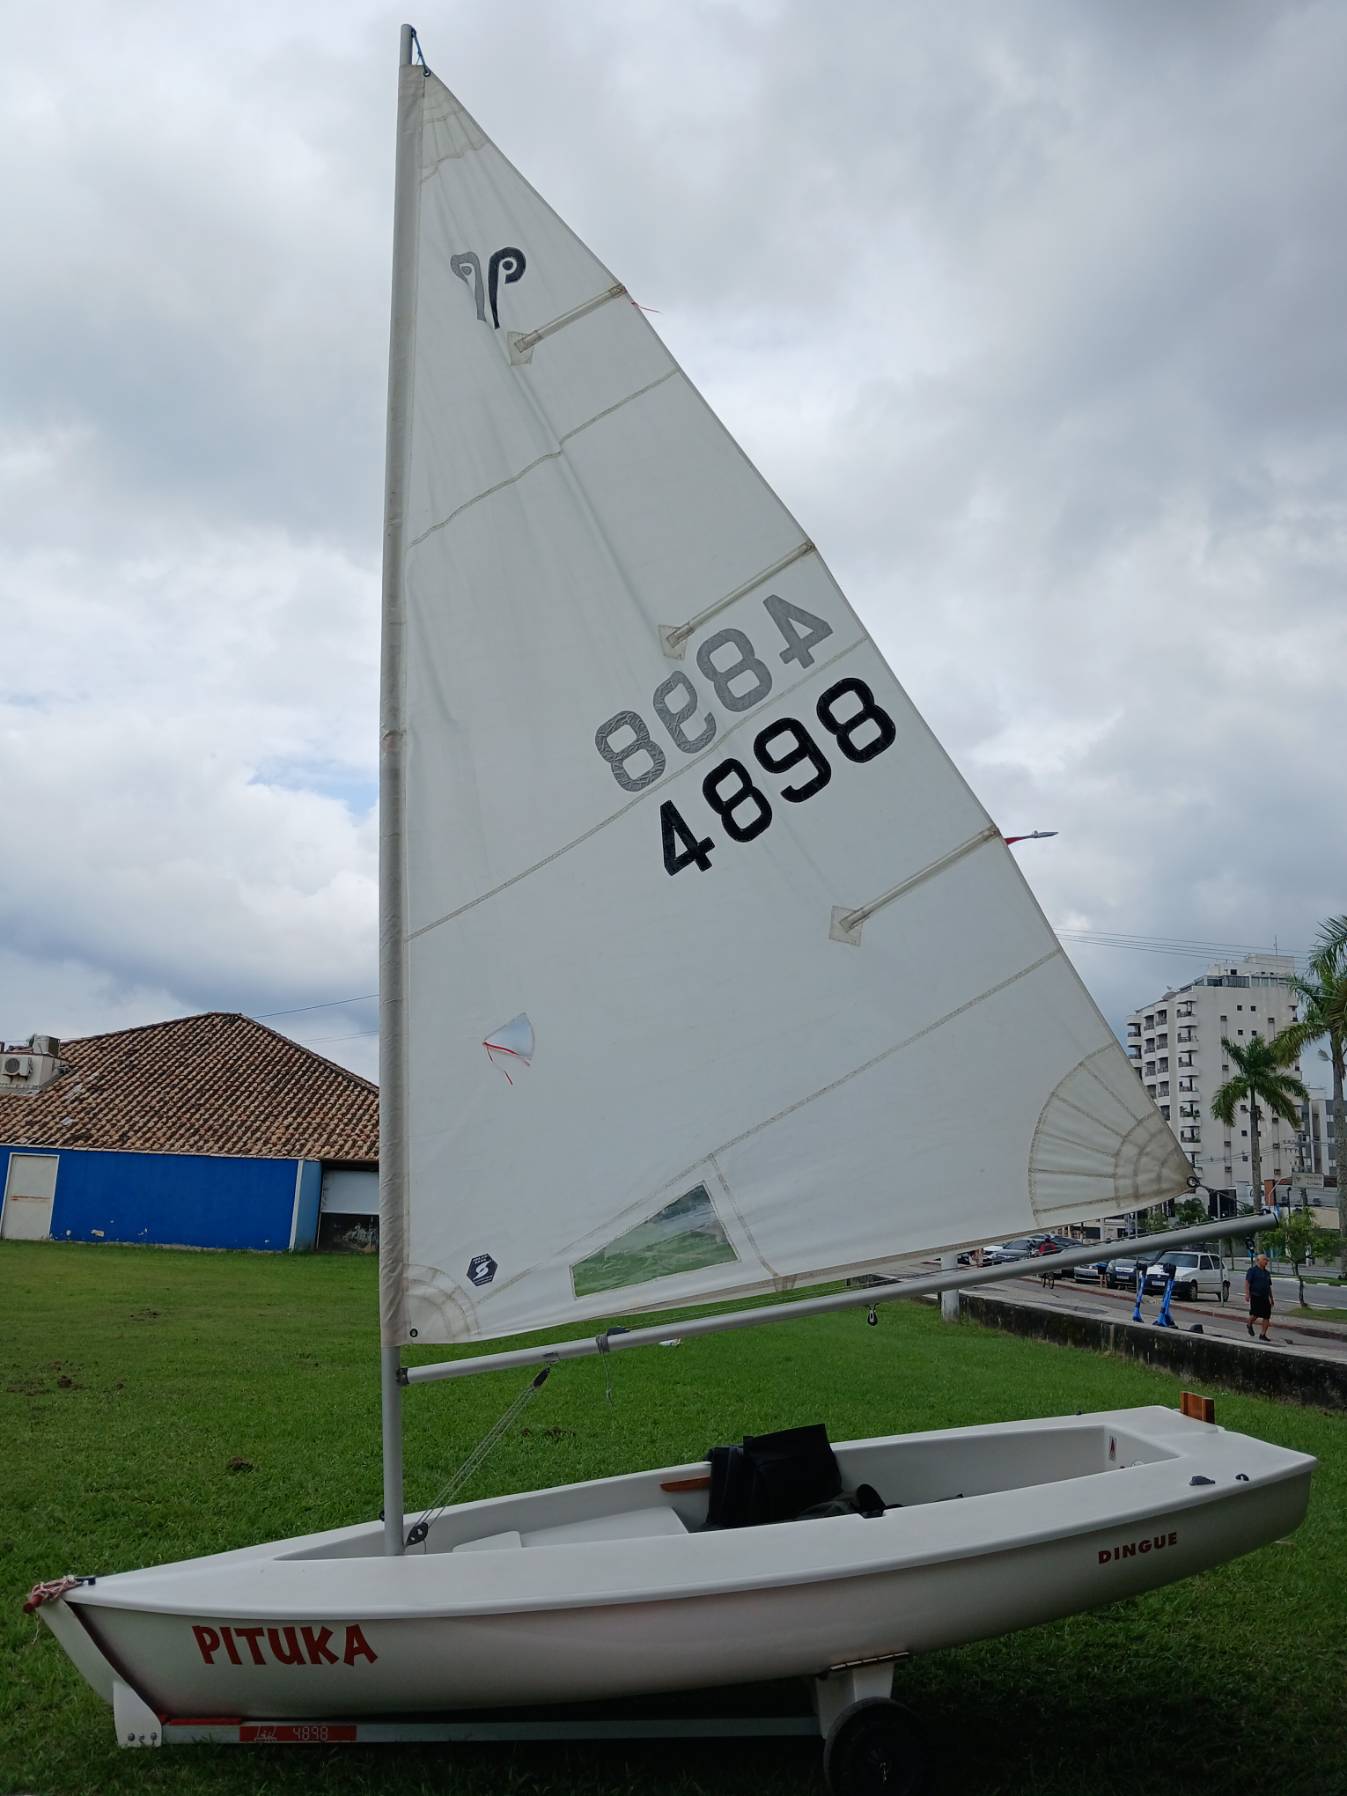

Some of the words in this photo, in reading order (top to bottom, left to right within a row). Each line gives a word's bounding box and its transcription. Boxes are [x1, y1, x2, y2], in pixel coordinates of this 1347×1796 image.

[660, 677, 896, 876] 4898
[1098, 1532, 1177, 1564] DINGUE
[192, 1624, 378, 1666] PITUKA
[292, 1726, 329, 1741] 4898
